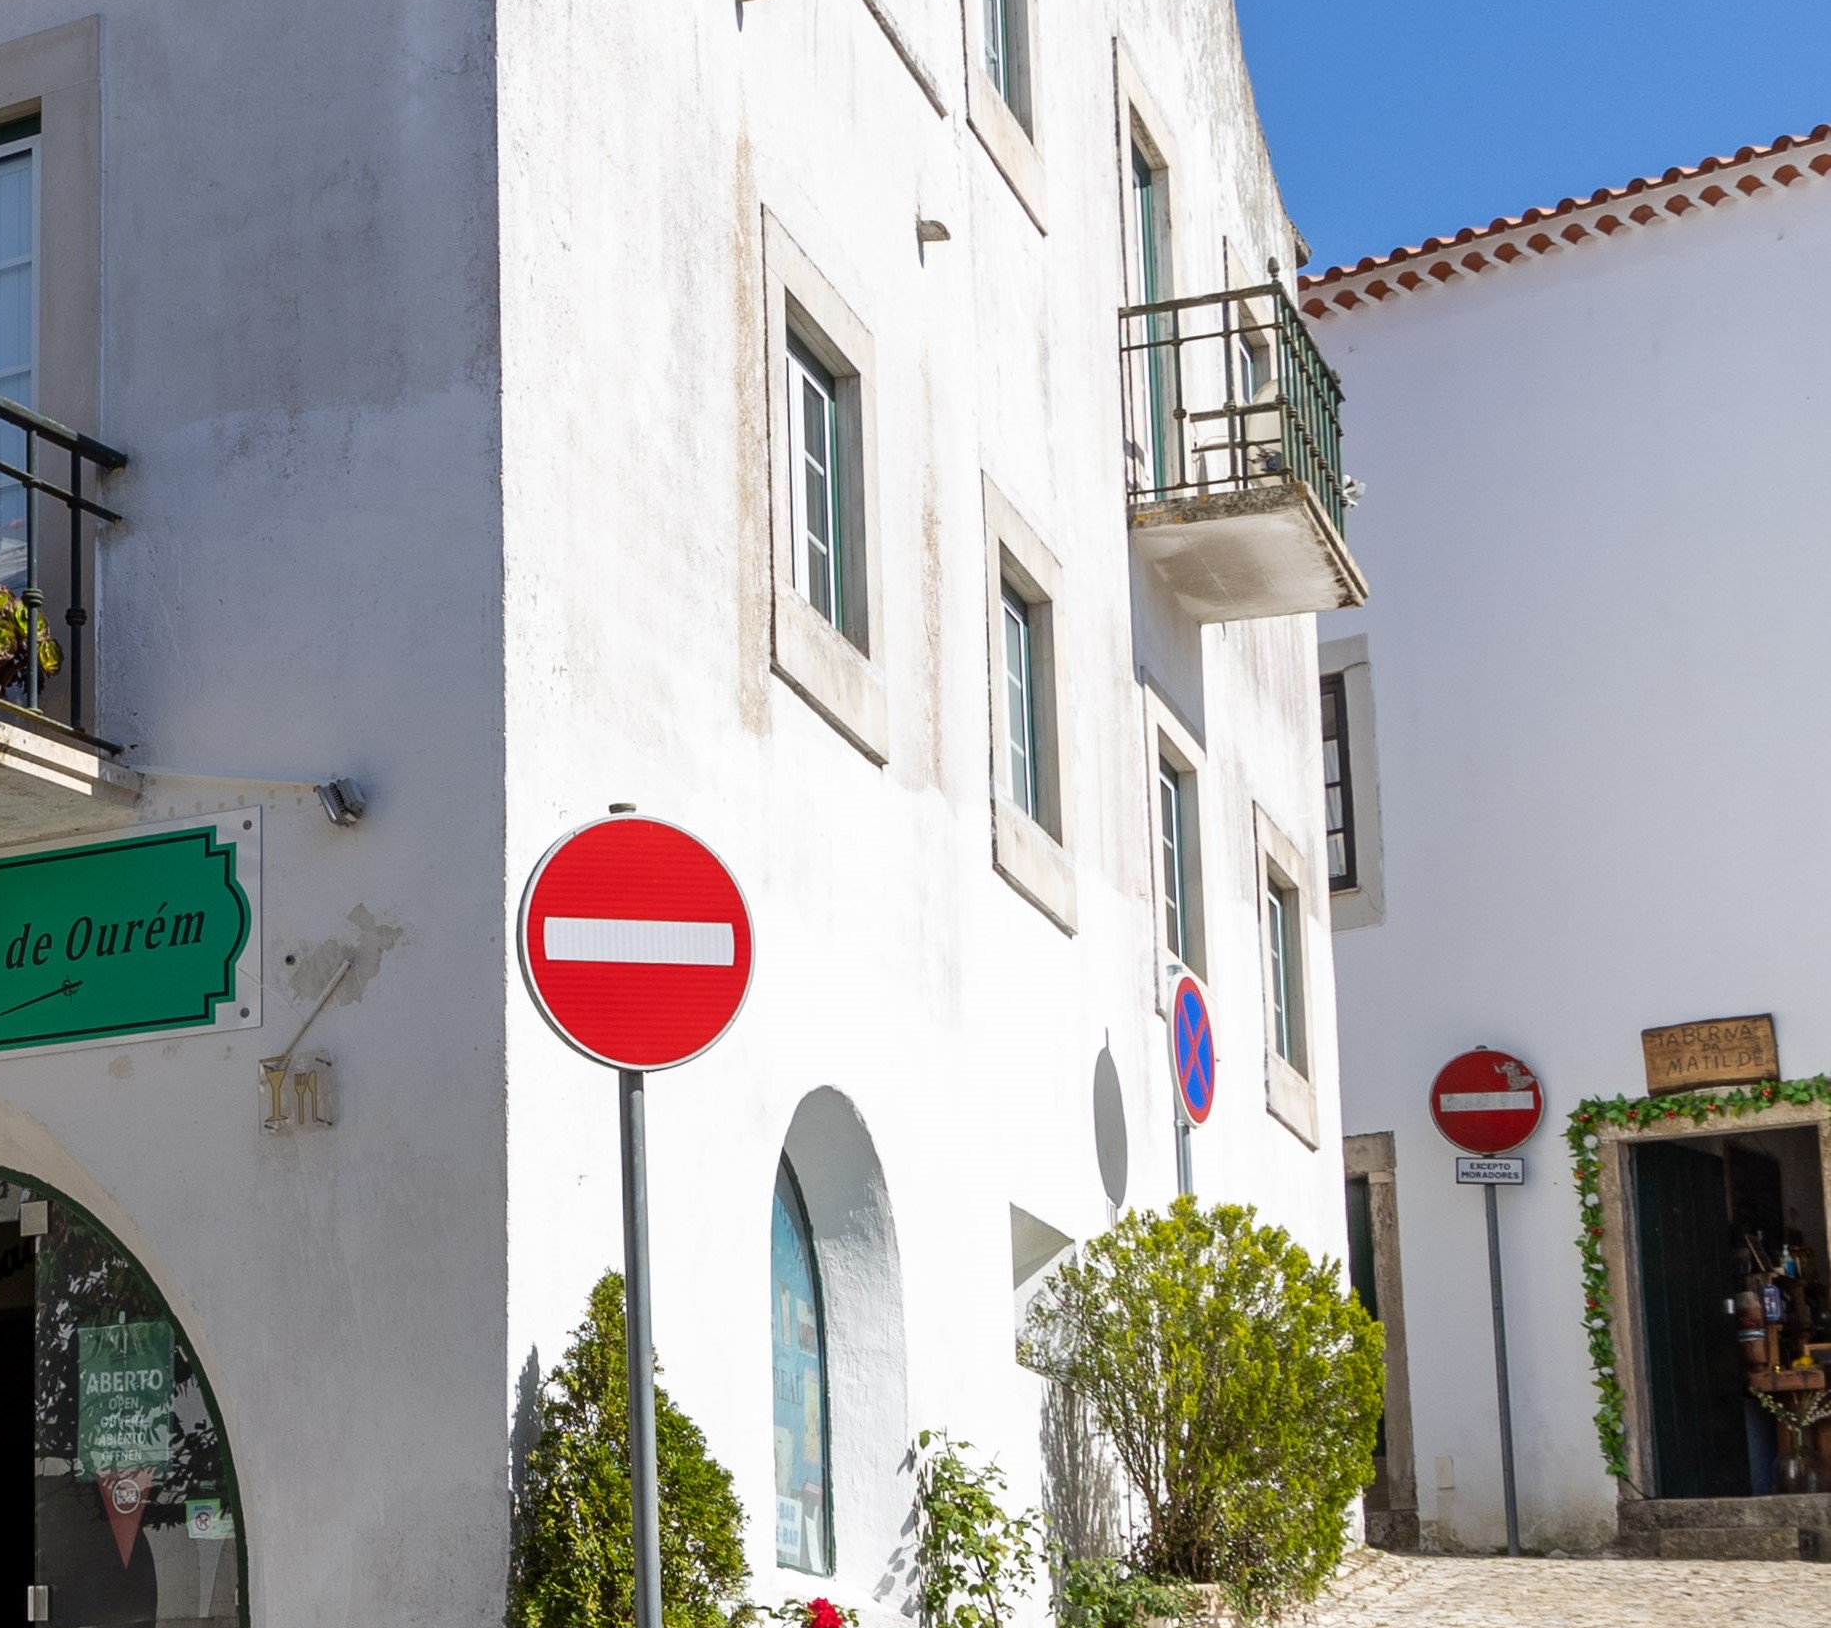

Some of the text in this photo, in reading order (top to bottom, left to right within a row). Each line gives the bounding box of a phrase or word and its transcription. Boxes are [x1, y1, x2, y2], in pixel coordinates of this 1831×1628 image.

[5, 923, 53, 970] de
[65, 902, 206, 962] Ourém
[1656, 1024, 1754, 1048] TABERNA
[1666, 1051, 1764, 1076] MATILDE
[1460, 1171, 1520, 1180] MORADORES
[1469, 1162, 1511, 1171] EXCEPTO
[85, 1369, 164, 1396] ABERTO
[108, 1396, 140, 1410] OPEN
[98, 1431, 147, 1447] ABIERTO
